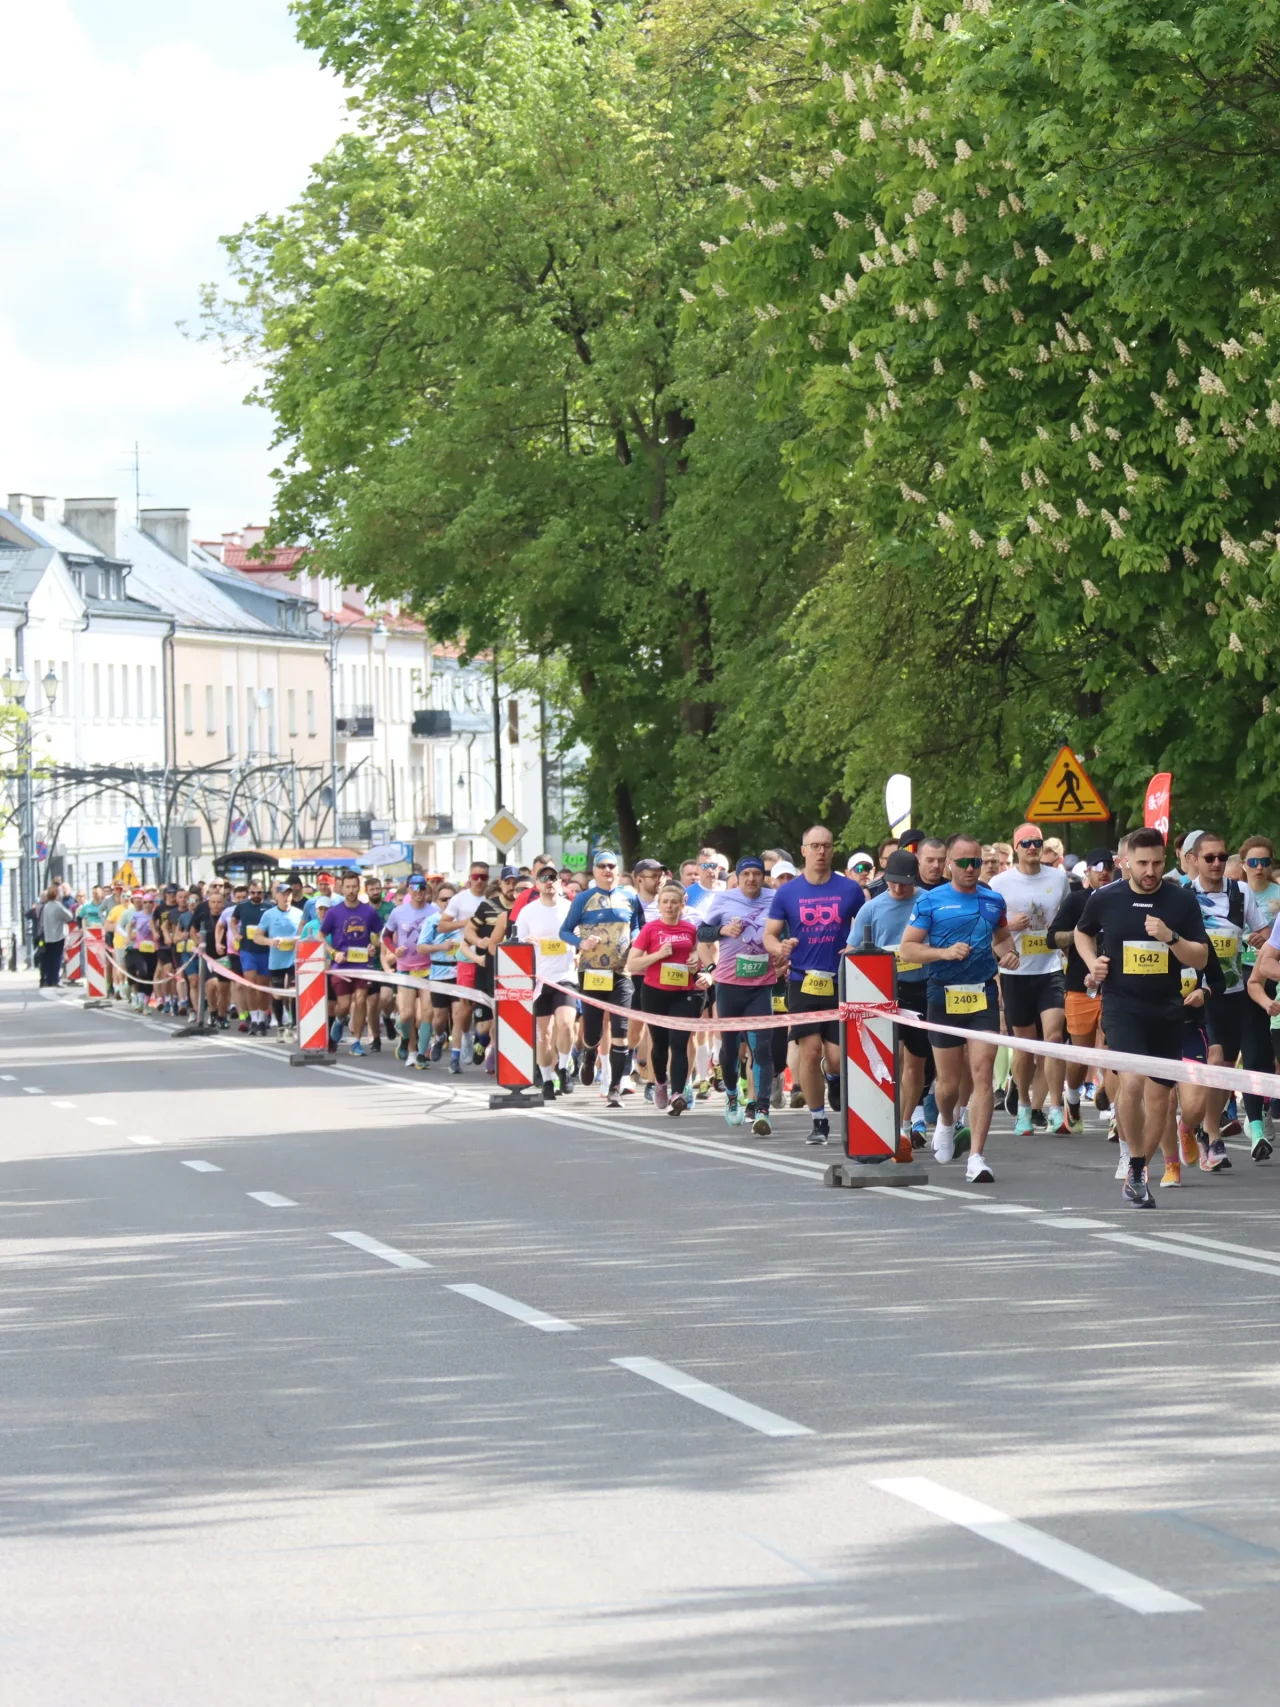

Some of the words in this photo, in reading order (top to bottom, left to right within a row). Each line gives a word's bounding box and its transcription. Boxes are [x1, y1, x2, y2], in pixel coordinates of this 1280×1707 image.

[548, 942, 560, 950] 269
[1213, 940, 1231, 948] 518
[1132, 953, 1160, 963] 1642
[741, 962, 763, 971] 2677
[667, 971, 684, 979] 1796
[808, 979, 829, 988] 2087
[953, 994, 978, 1005] 2403
